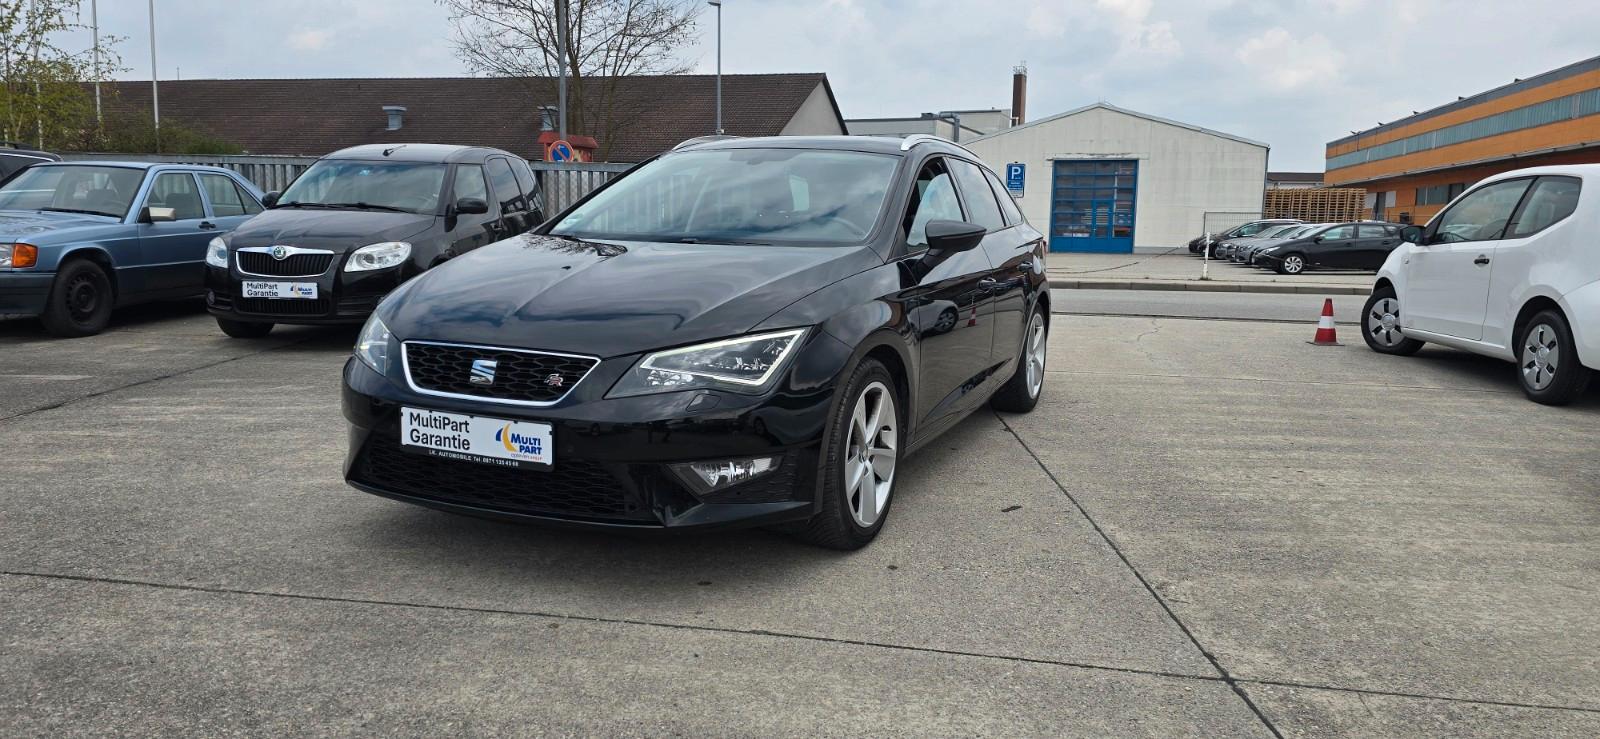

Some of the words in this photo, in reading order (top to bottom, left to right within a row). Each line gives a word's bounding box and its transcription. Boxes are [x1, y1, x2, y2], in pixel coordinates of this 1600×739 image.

[1011, 166, 1021, 179] P
[247, 282, 278, 290] MultiPart
[410, 412, 470, 433] MultiPart
[410, 428, 470, 450] Garantie
[511, 433, 541, 446] MULTI
[439, 451, 472, 461] AUTOMOBILE
[519, 445, 542, 455] PART
